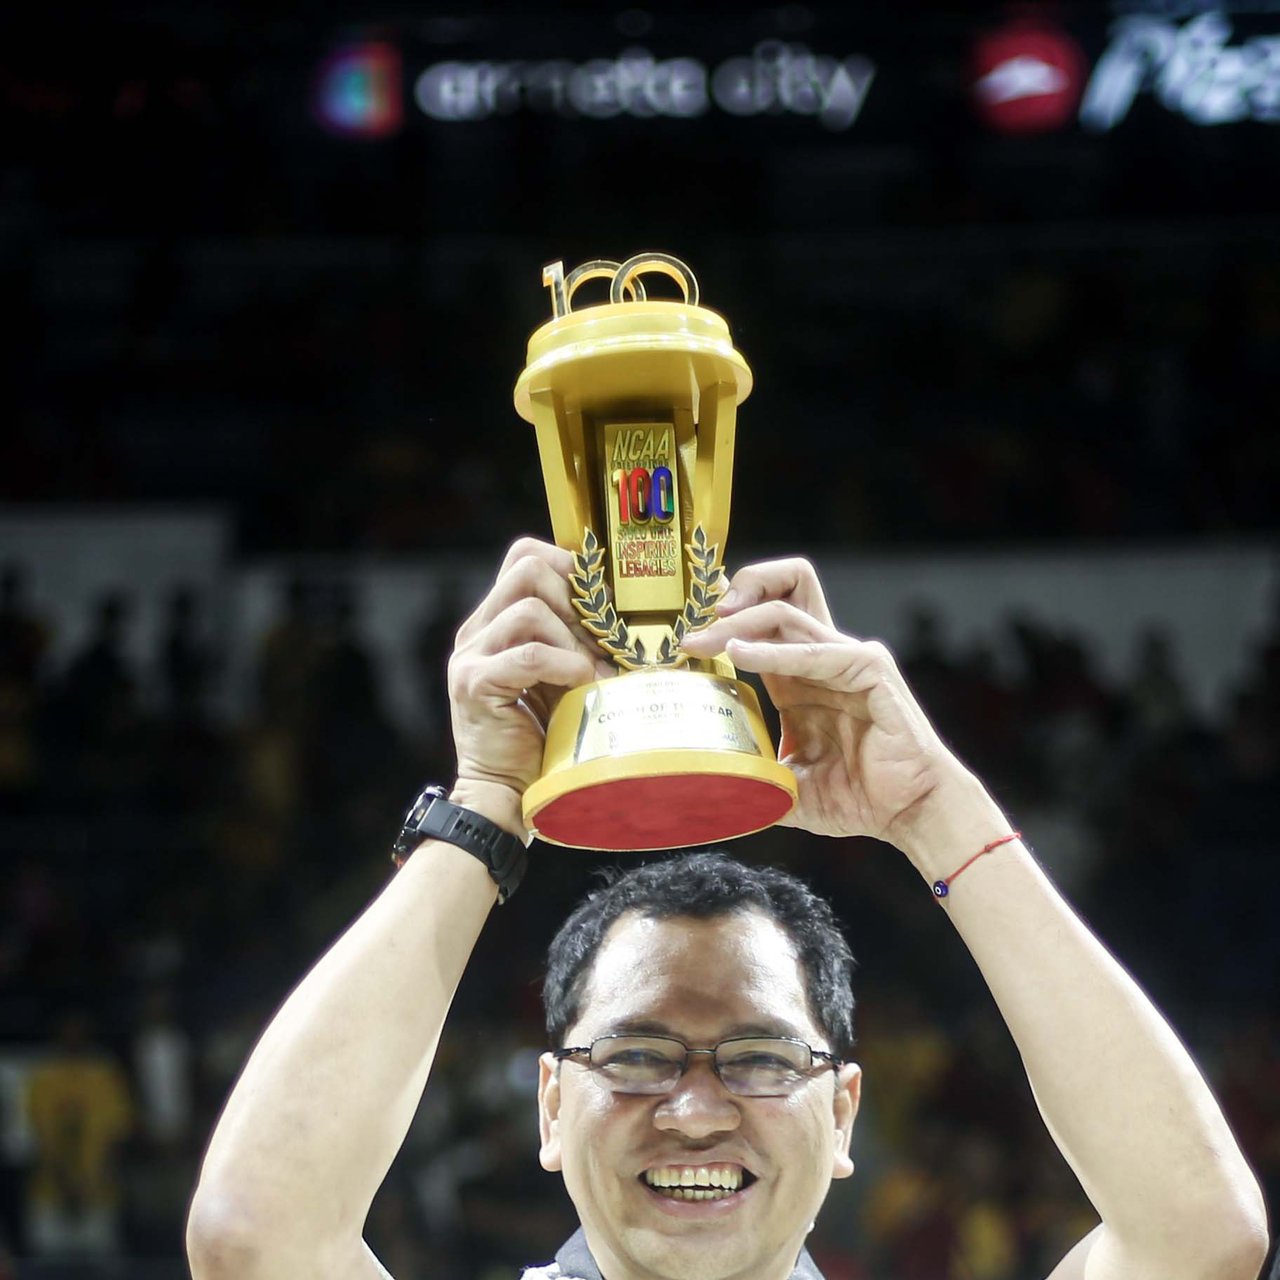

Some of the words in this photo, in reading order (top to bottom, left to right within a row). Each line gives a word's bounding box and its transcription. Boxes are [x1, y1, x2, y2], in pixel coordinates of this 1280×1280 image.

[542, 253, 699, 321] 100
[612, 428, 670, 461] NCAA
[611, 466, 675, 526] 100
[616, 540, 678, 560] INSPIRING
[619, 560, 677, 578] LEGACIES
